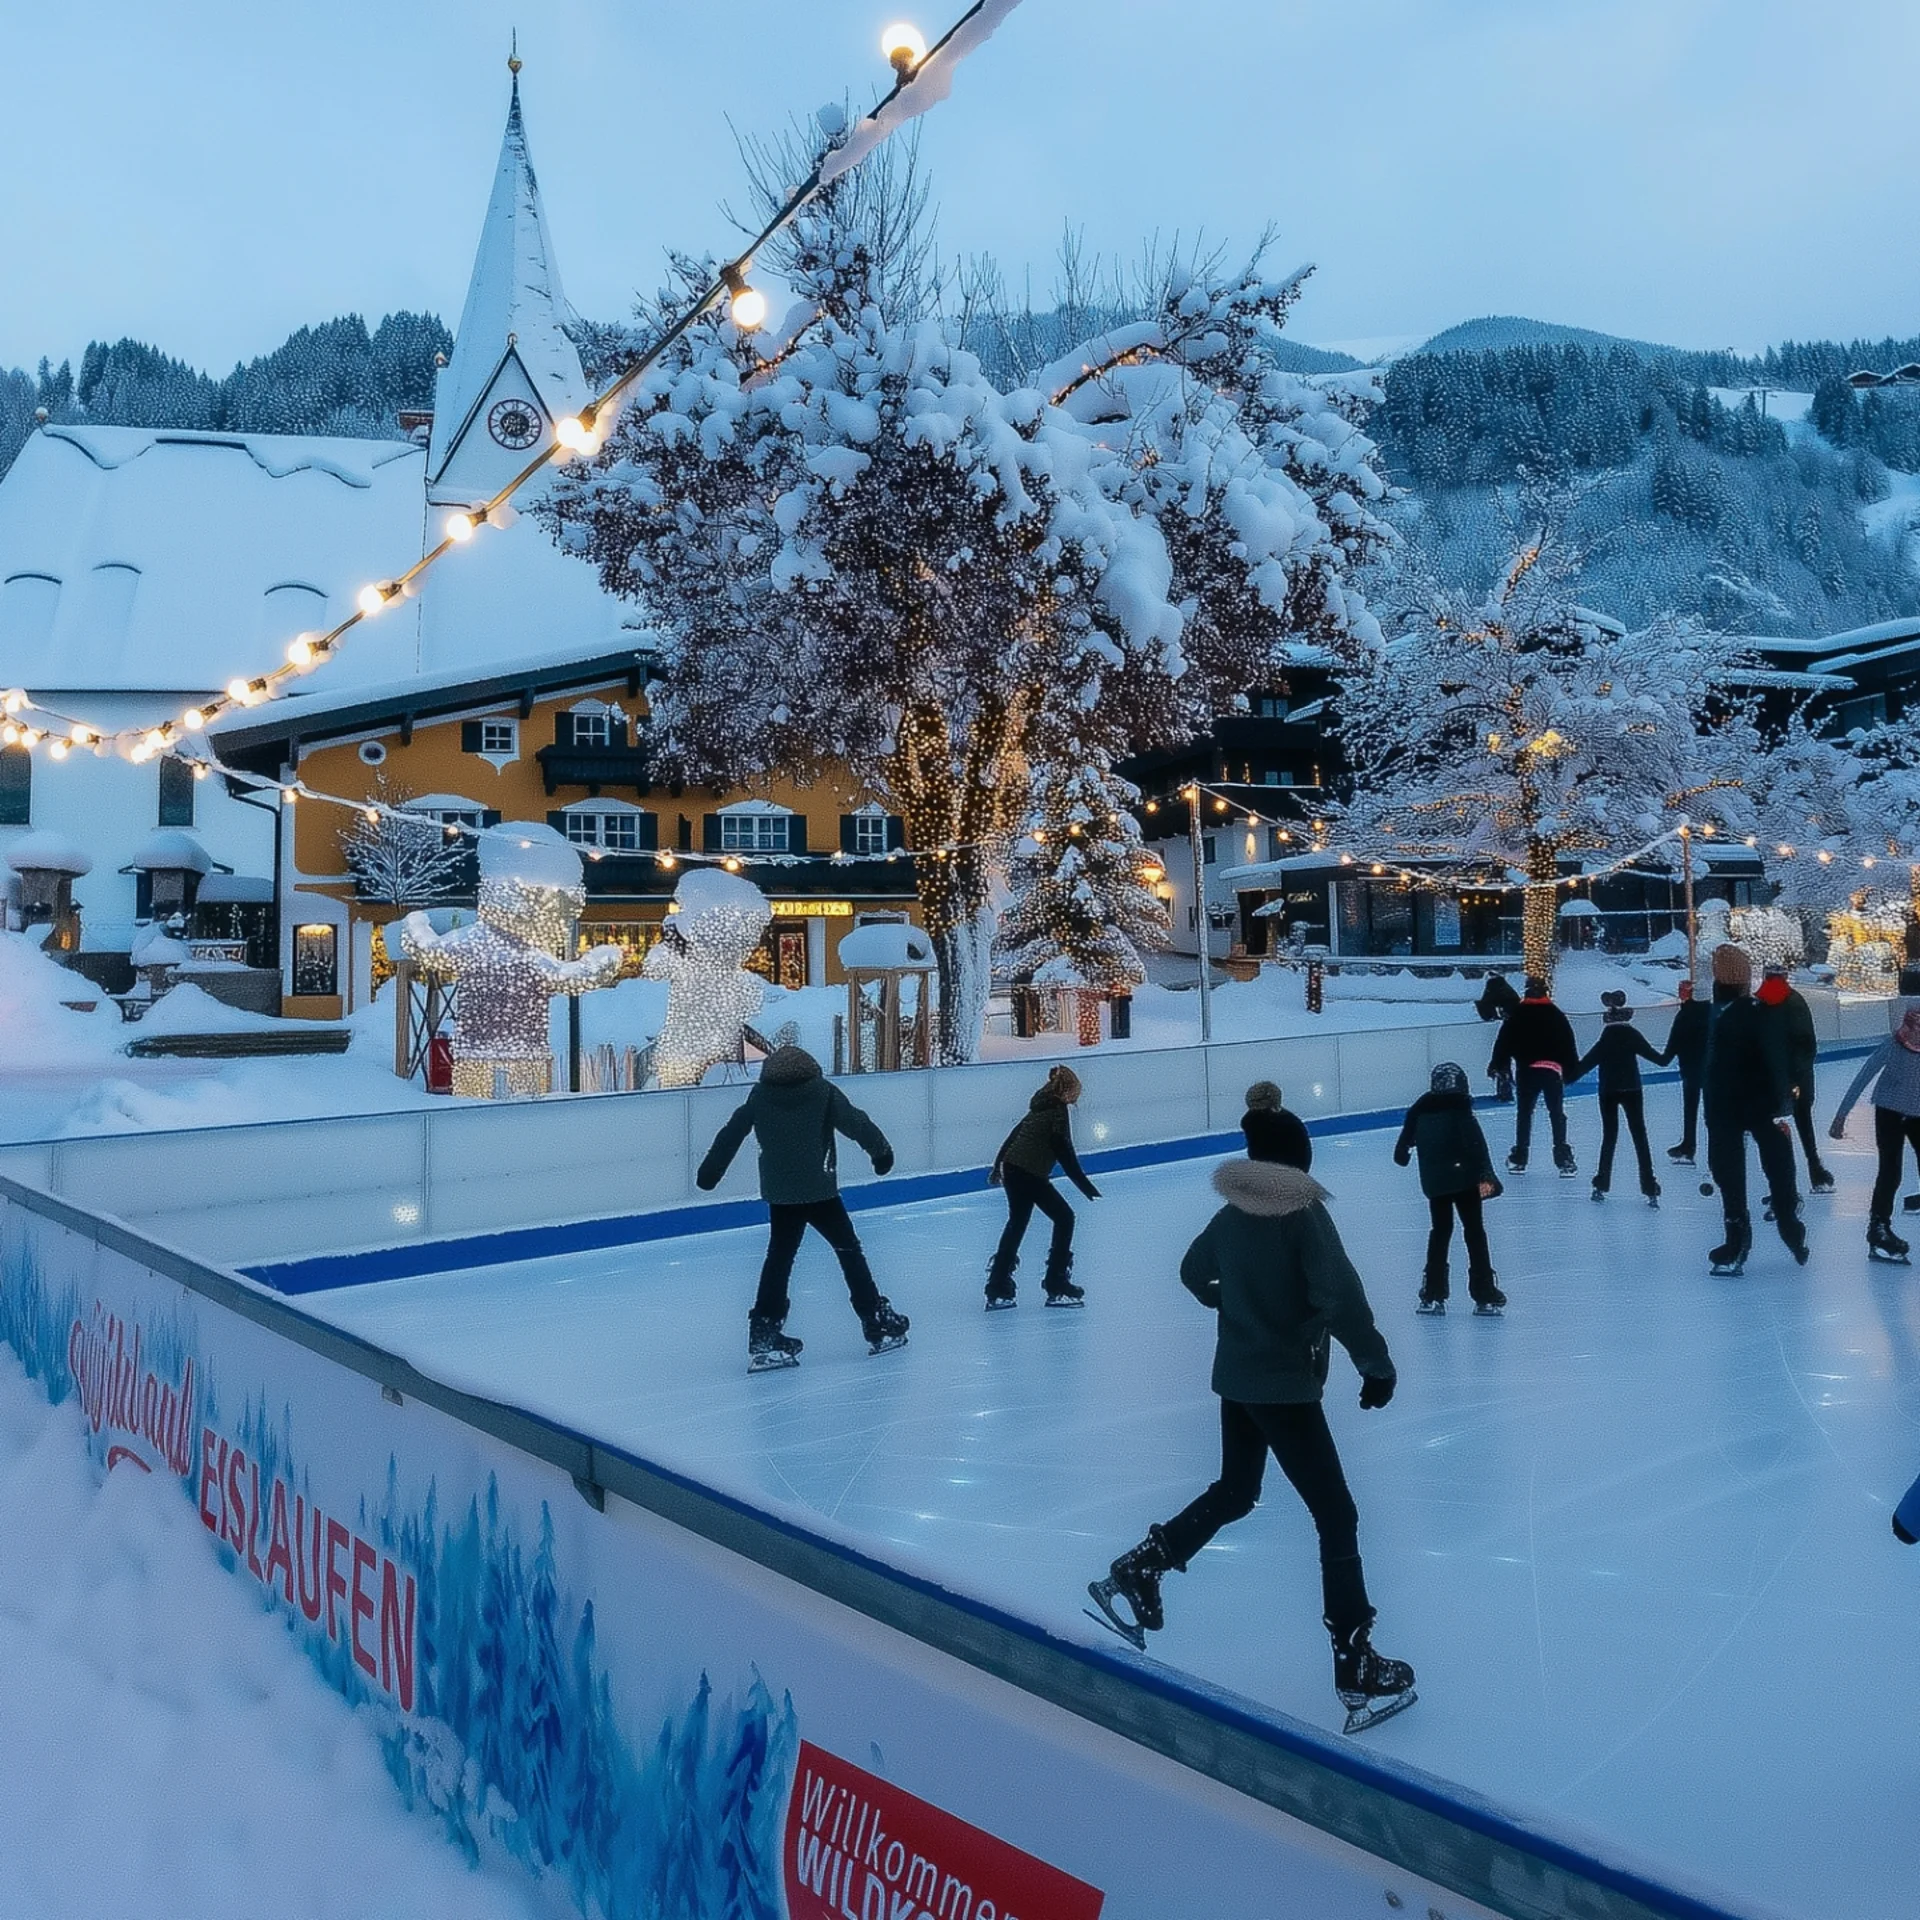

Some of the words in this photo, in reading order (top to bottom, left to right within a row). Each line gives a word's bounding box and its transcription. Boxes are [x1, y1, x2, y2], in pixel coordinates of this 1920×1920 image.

[200, 1427, 415, 1713] EISLAUFEN
[798, 1827, 936, 1920] WILDK
[801, 1769, 1019, 1920] Willkomme
